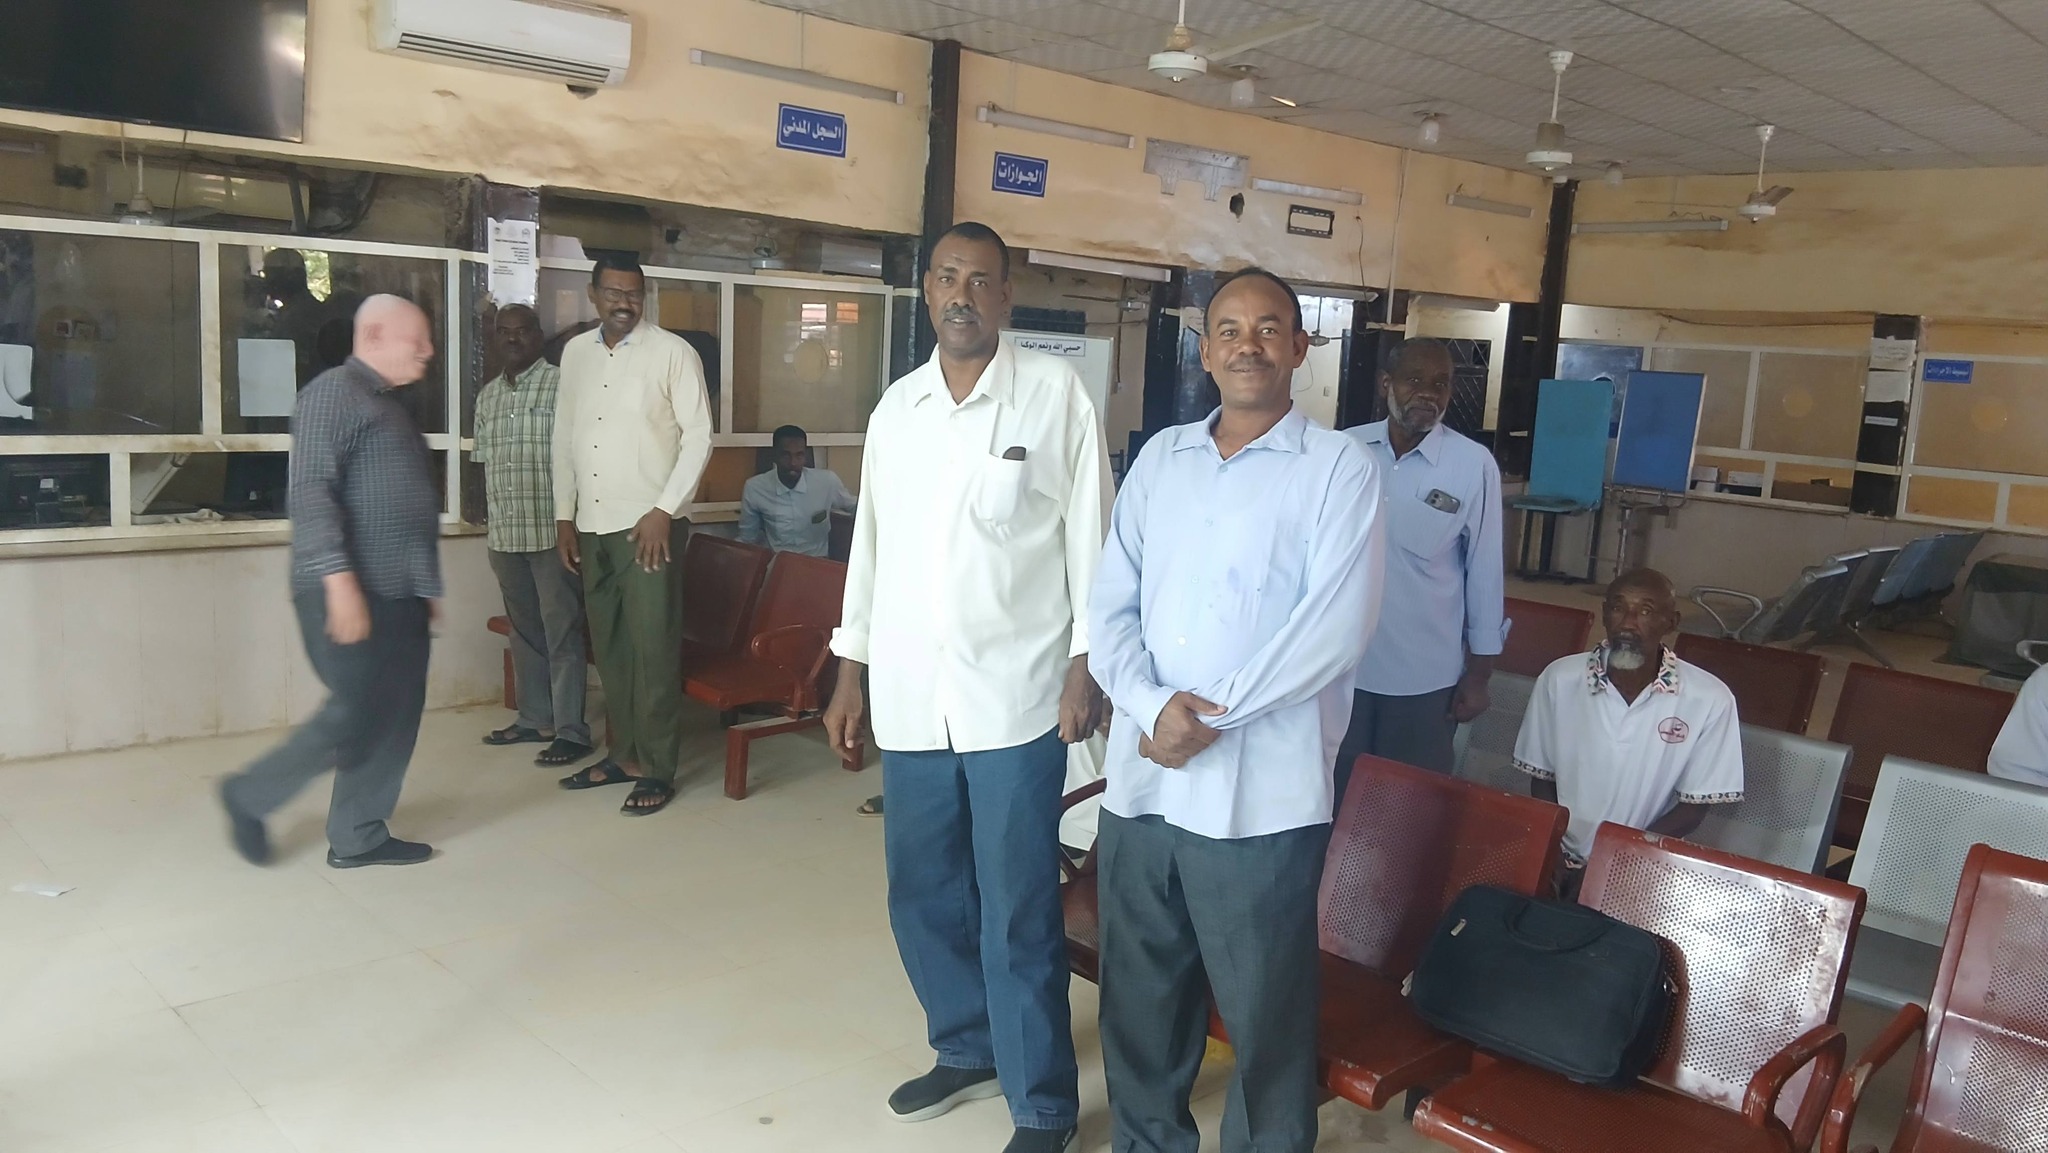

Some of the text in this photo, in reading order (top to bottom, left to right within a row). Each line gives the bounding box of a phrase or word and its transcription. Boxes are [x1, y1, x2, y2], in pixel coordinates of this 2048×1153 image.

[782, 115, 842, 141] السجل المدني
[997, 160, 1043, 186] الجوازات
[1037, 341, 1052, 351] ونعم
[1052, 341, 1063, 350] الله
[1063, 344, 1081, 353] حسبي
